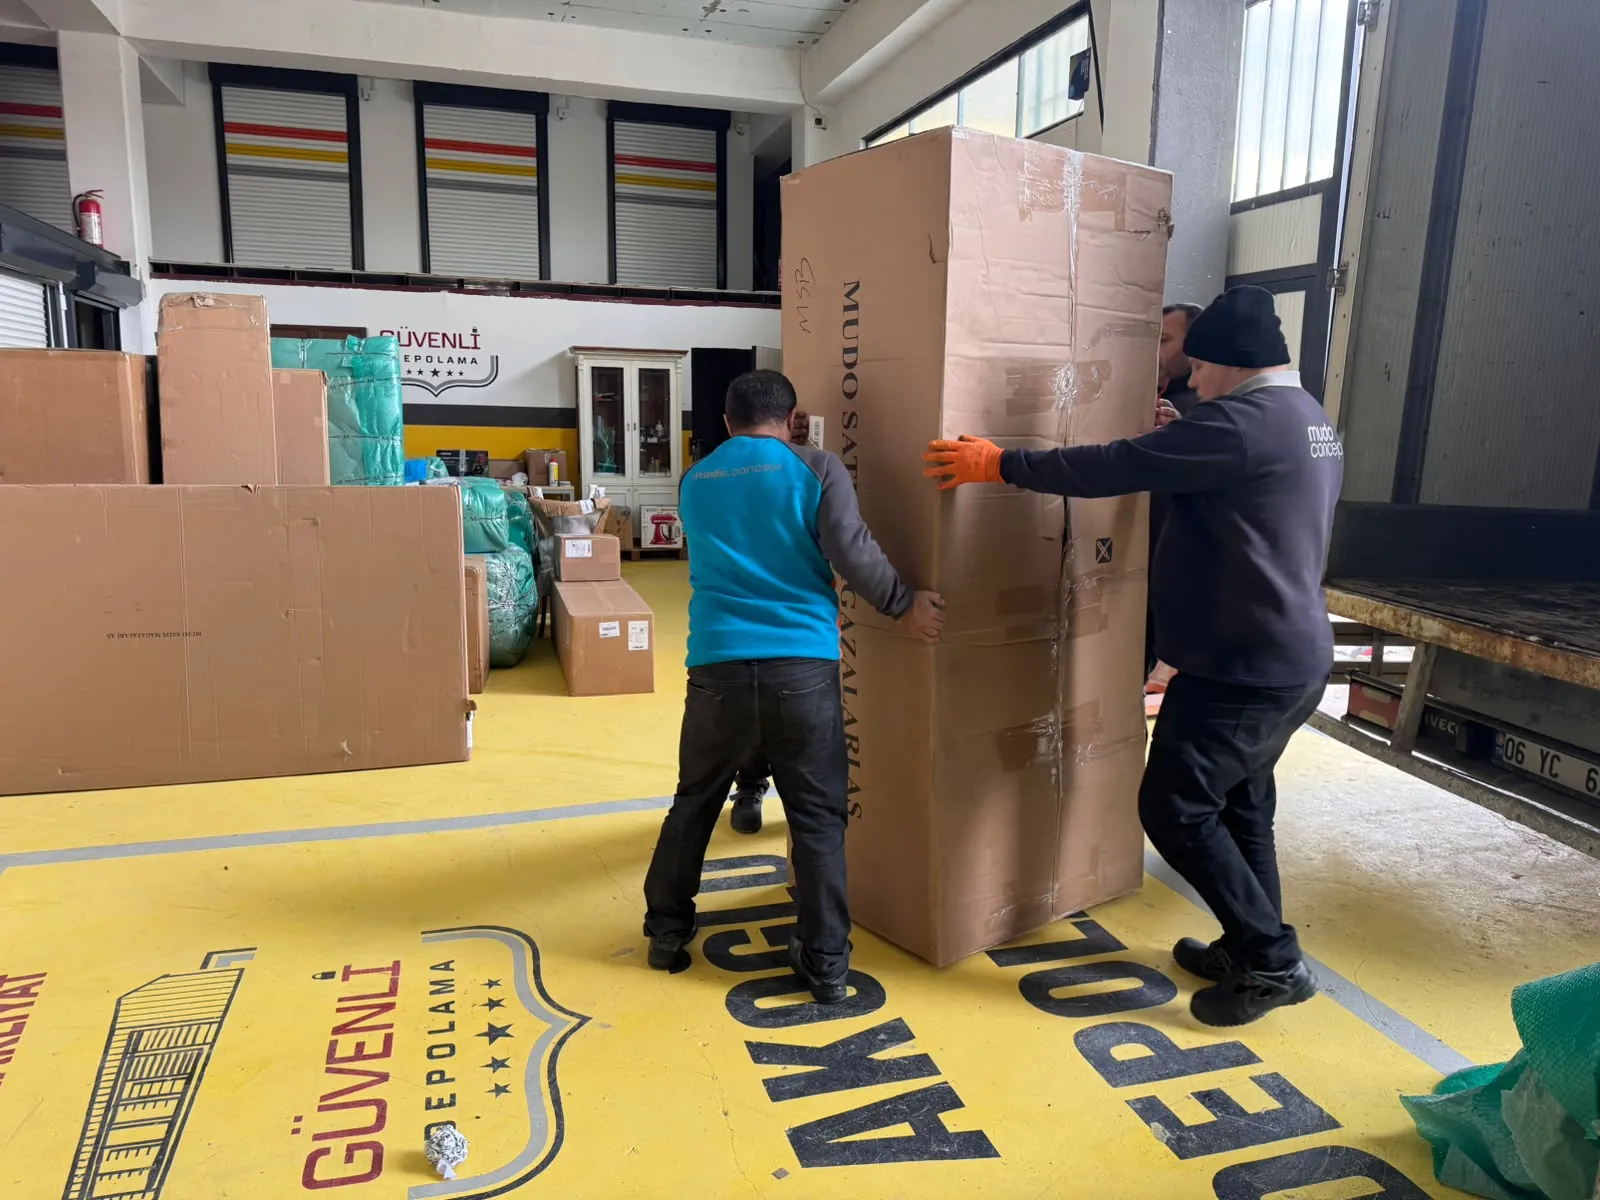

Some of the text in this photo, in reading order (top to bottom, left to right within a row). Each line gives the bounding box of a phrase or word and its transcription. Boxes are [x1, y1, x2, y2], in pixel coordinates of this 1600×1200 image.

[403, 354, 478, 365] EPOLAMA
[842, 278, 860, 400] MUDO
[841, 411, 858, 490] SAT
[1308, 422, 1334, 442] mudo
[1311, 442, 1343, 460] concep
[841, 577, 861, 768] GAZALARI
[1504, 737, 1600, 796] 06 YC 6
[985, 911, 1433, 1200] DEPOL
